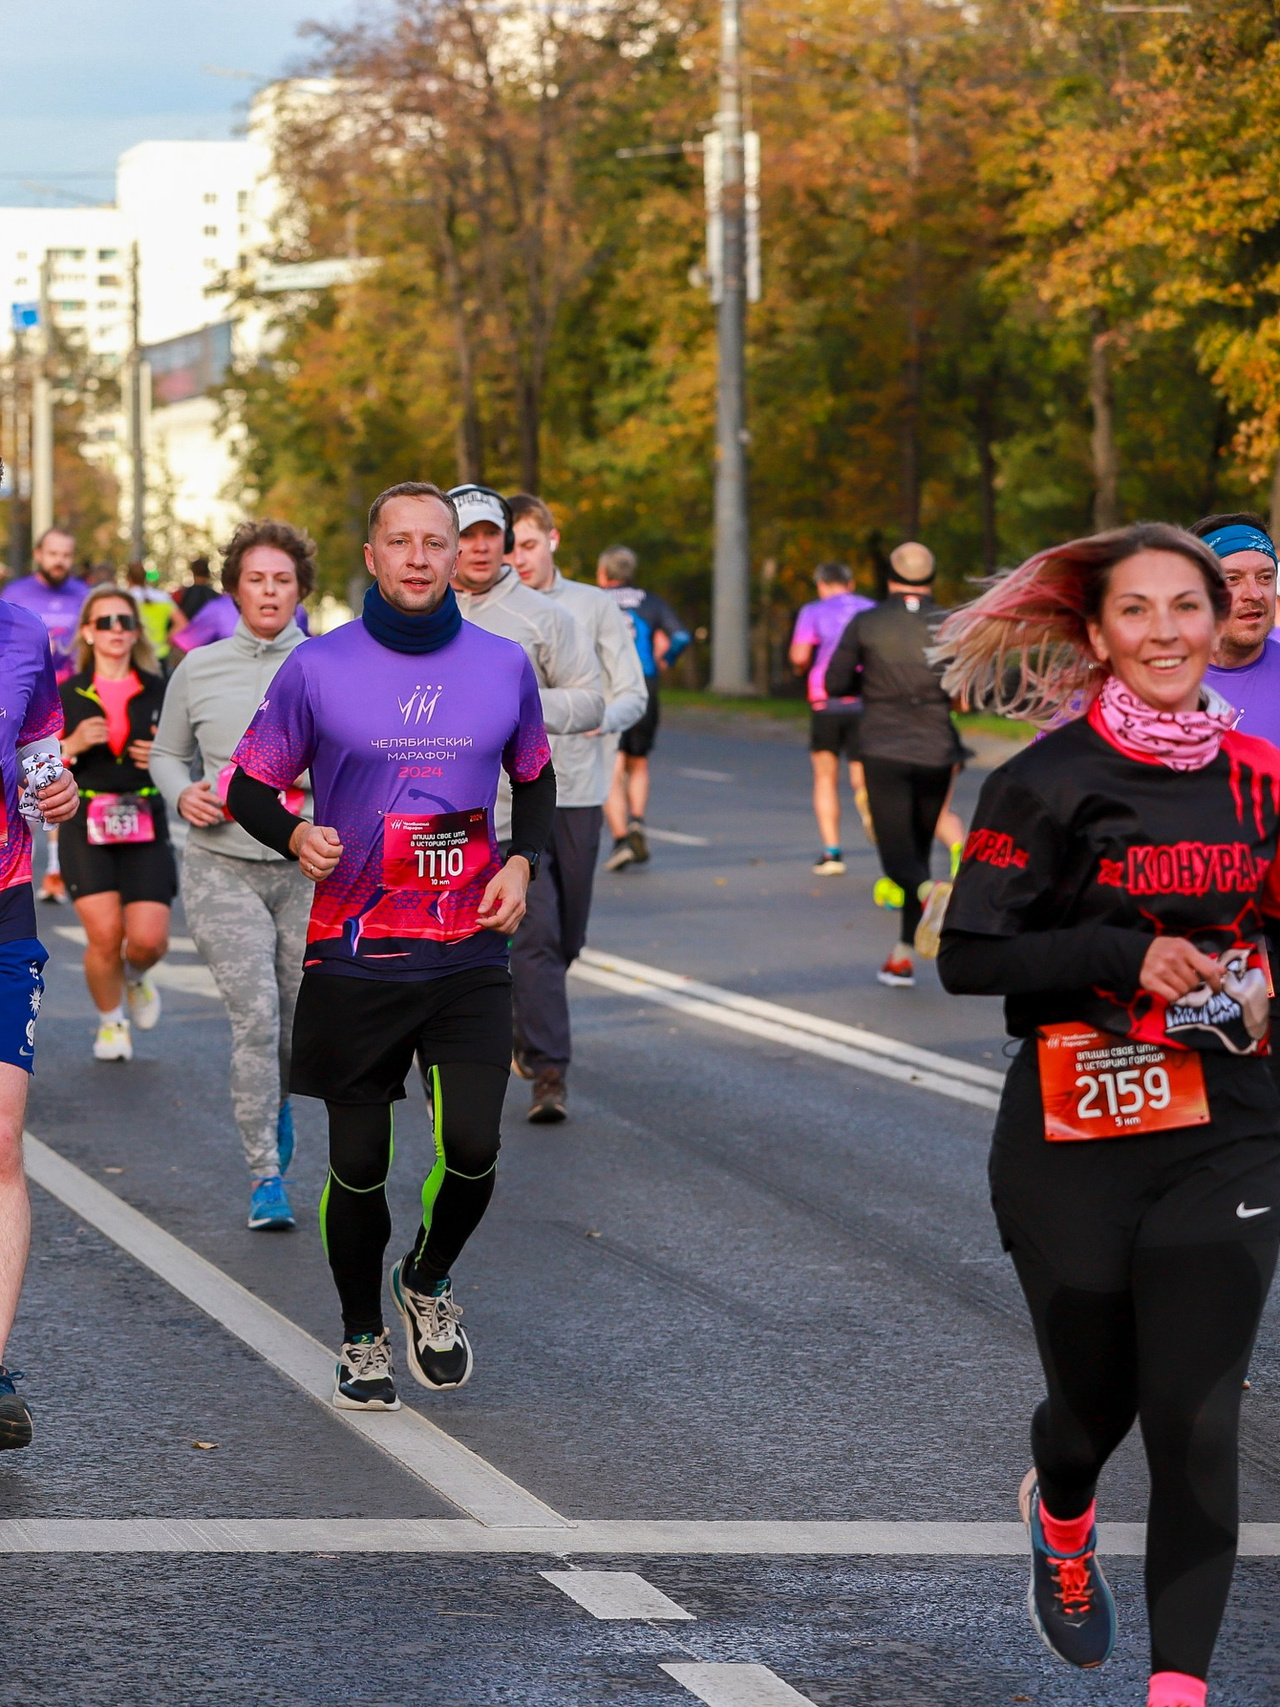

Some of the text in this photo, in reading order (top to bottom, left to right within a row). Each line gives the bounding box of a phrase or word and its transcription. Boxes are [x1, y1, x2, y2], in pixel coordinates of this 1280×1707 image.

[370, 736, 473, 748] ЧЕЛЯБИНСКИЙ
[387, 751, 456, 761] МАРАФОН
[398, 766, 443, 778] 2024
[412, 830, 465, 841] ВПИШИ СВОЕ ИМЯ
[447, 837, 468, 845] ГОРОДА
[414, 848, 464, 878] 1110
[1127, 842, 1258, 896] КОНУРА
[431, 878, 438, 886] 10
[1076, 1050, 1110, 1062] ВПИШИ
[1110, 1045, 1134, 1058] СВОЕ
[1075, 1052, 1166, 1072] В ИСТОРИЮ ГОРОДА
[1074, 1066, 1171, 1119] 2159
[1114, 1117, 1122, 1127] 5
